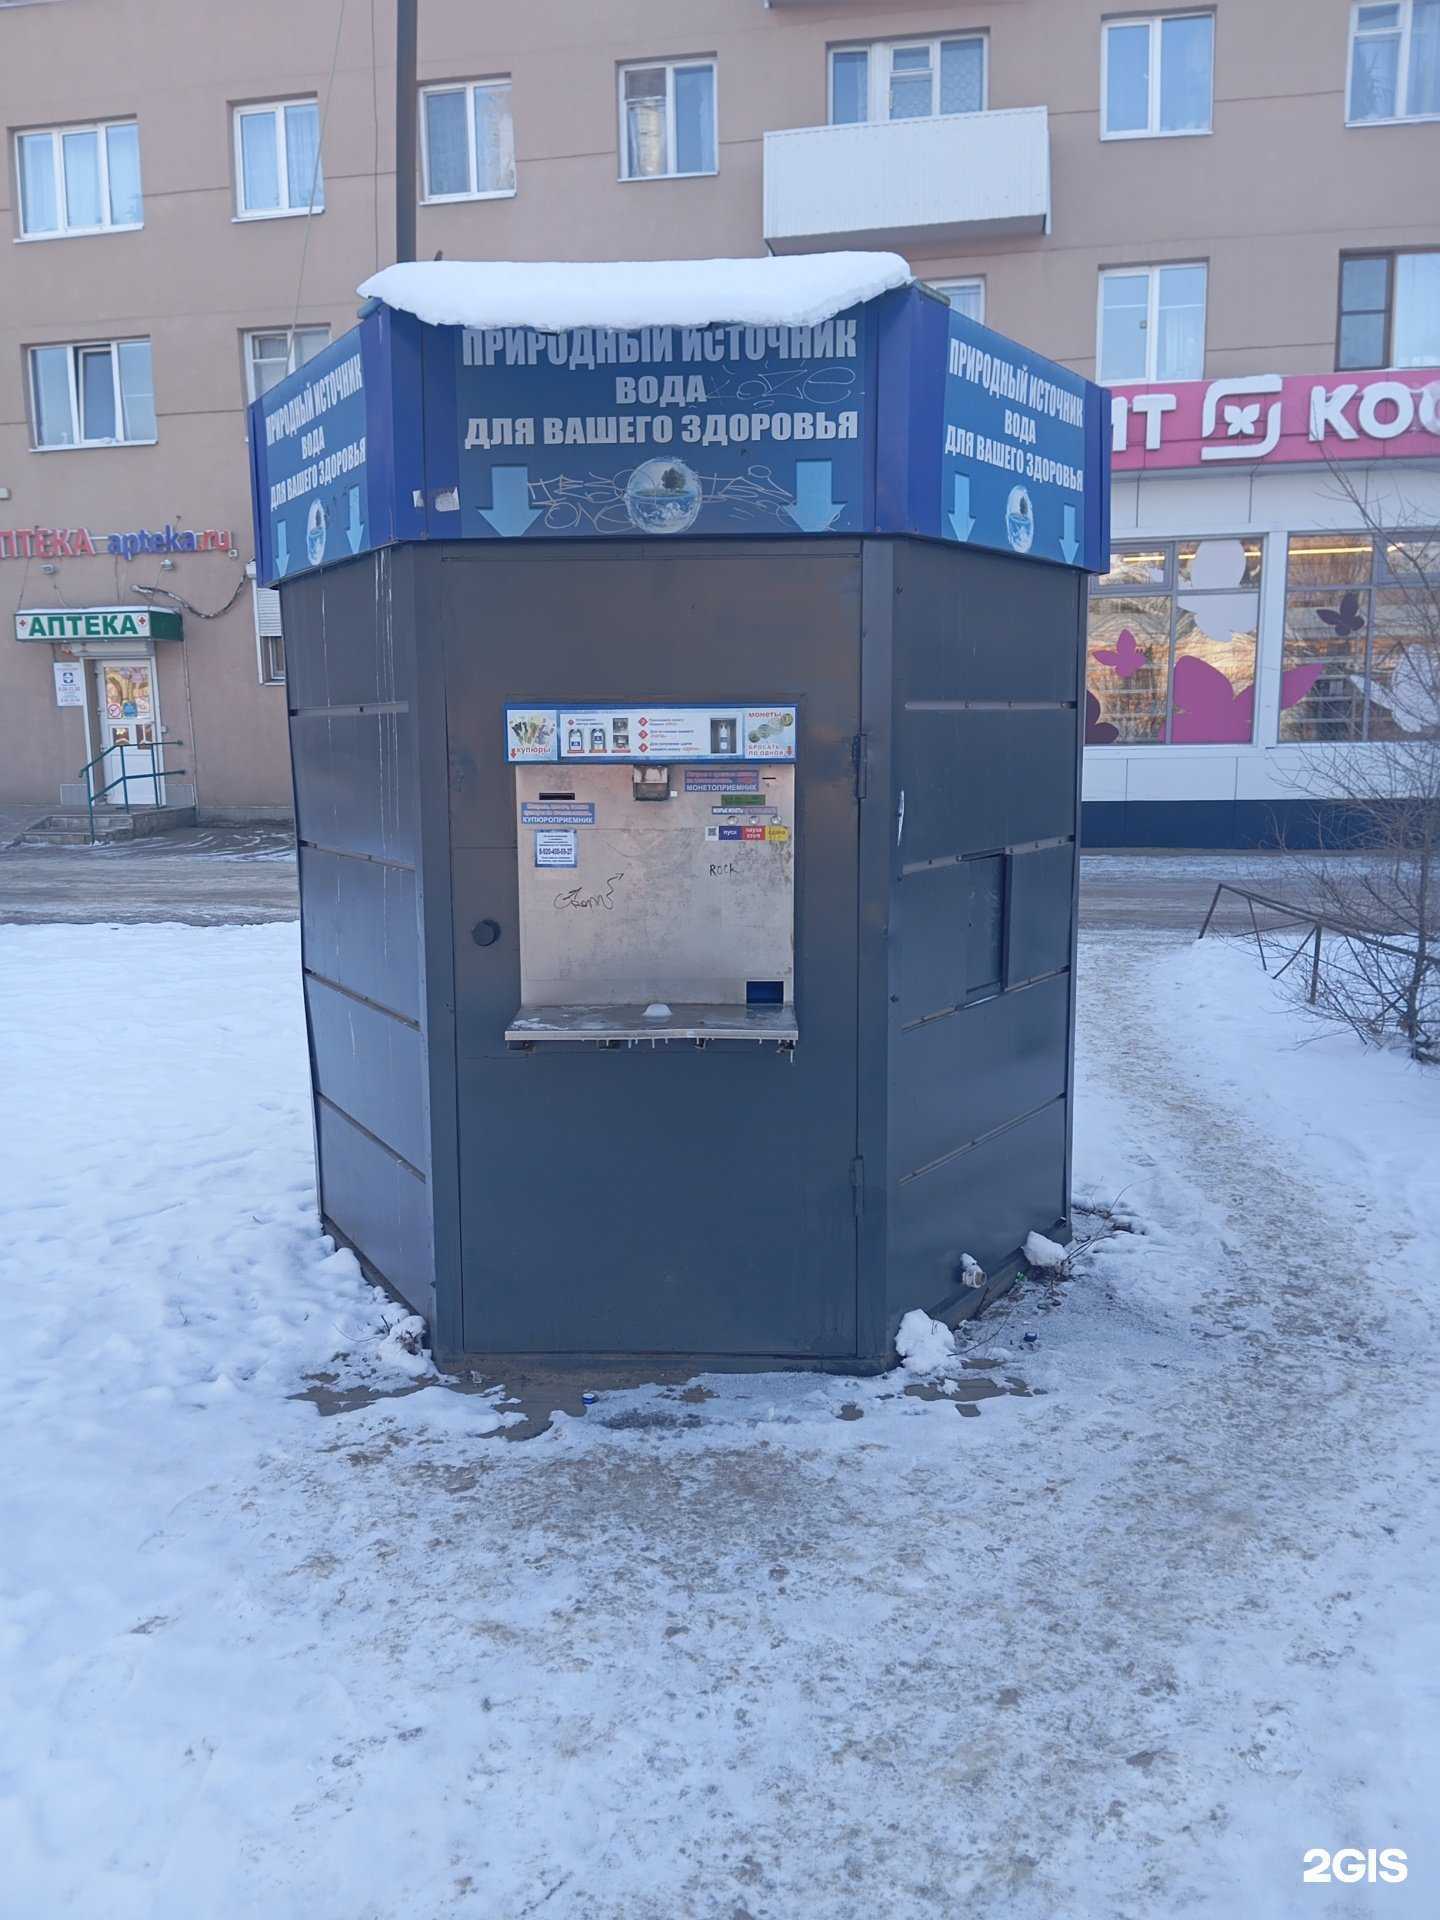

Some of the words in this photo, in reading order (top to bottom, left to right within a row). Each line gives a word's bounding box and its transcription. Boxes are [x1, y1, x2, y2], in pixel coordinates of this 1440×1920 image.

[681, 319, 857, 362] ИСТОЧНИК
[265, 383, 314, 447] ПРИРОДНЫЙ
[314, 353, 363, 416] ИСТОЧНИК
[615, 374, 708, 408] ВОДА
[949, 338, 1028, 404] ПРИРОДНЫЙ
[1028, 374, 1084, 428] ИСТОЧНИК
[301, 425, 326, 460] ВОДА
[464, 417, 535, 450] ДЛЯ
[543, 414, 674, 446] ВАШЕГО
[681, 410, 859, 447] ЗДОРОВЬЯ
[1004, 409, 1037, 444] ВОДА
[270, 480, 287, 513] ДЛЯ
[286, 467, 319, 501] ВАШЕГО
[318, 436, 367, 488] ЗДОРОВЬЯ
[945, 424, 974, 458] ДЛЯ
[976, 435, 1025, 475] ВАШЕГО
[1025, 454, 1084, 493] ЗДОРОВЬЯ
[107, 524, 232, 560] apteka.ru
[28, 614, 139, 637] АПТЕКА
[686, 783, 758, 792] МОНЕТОПРИЕМНИК
[522, 816, 594, 824] КУПЮРОПРИЕМНИК
